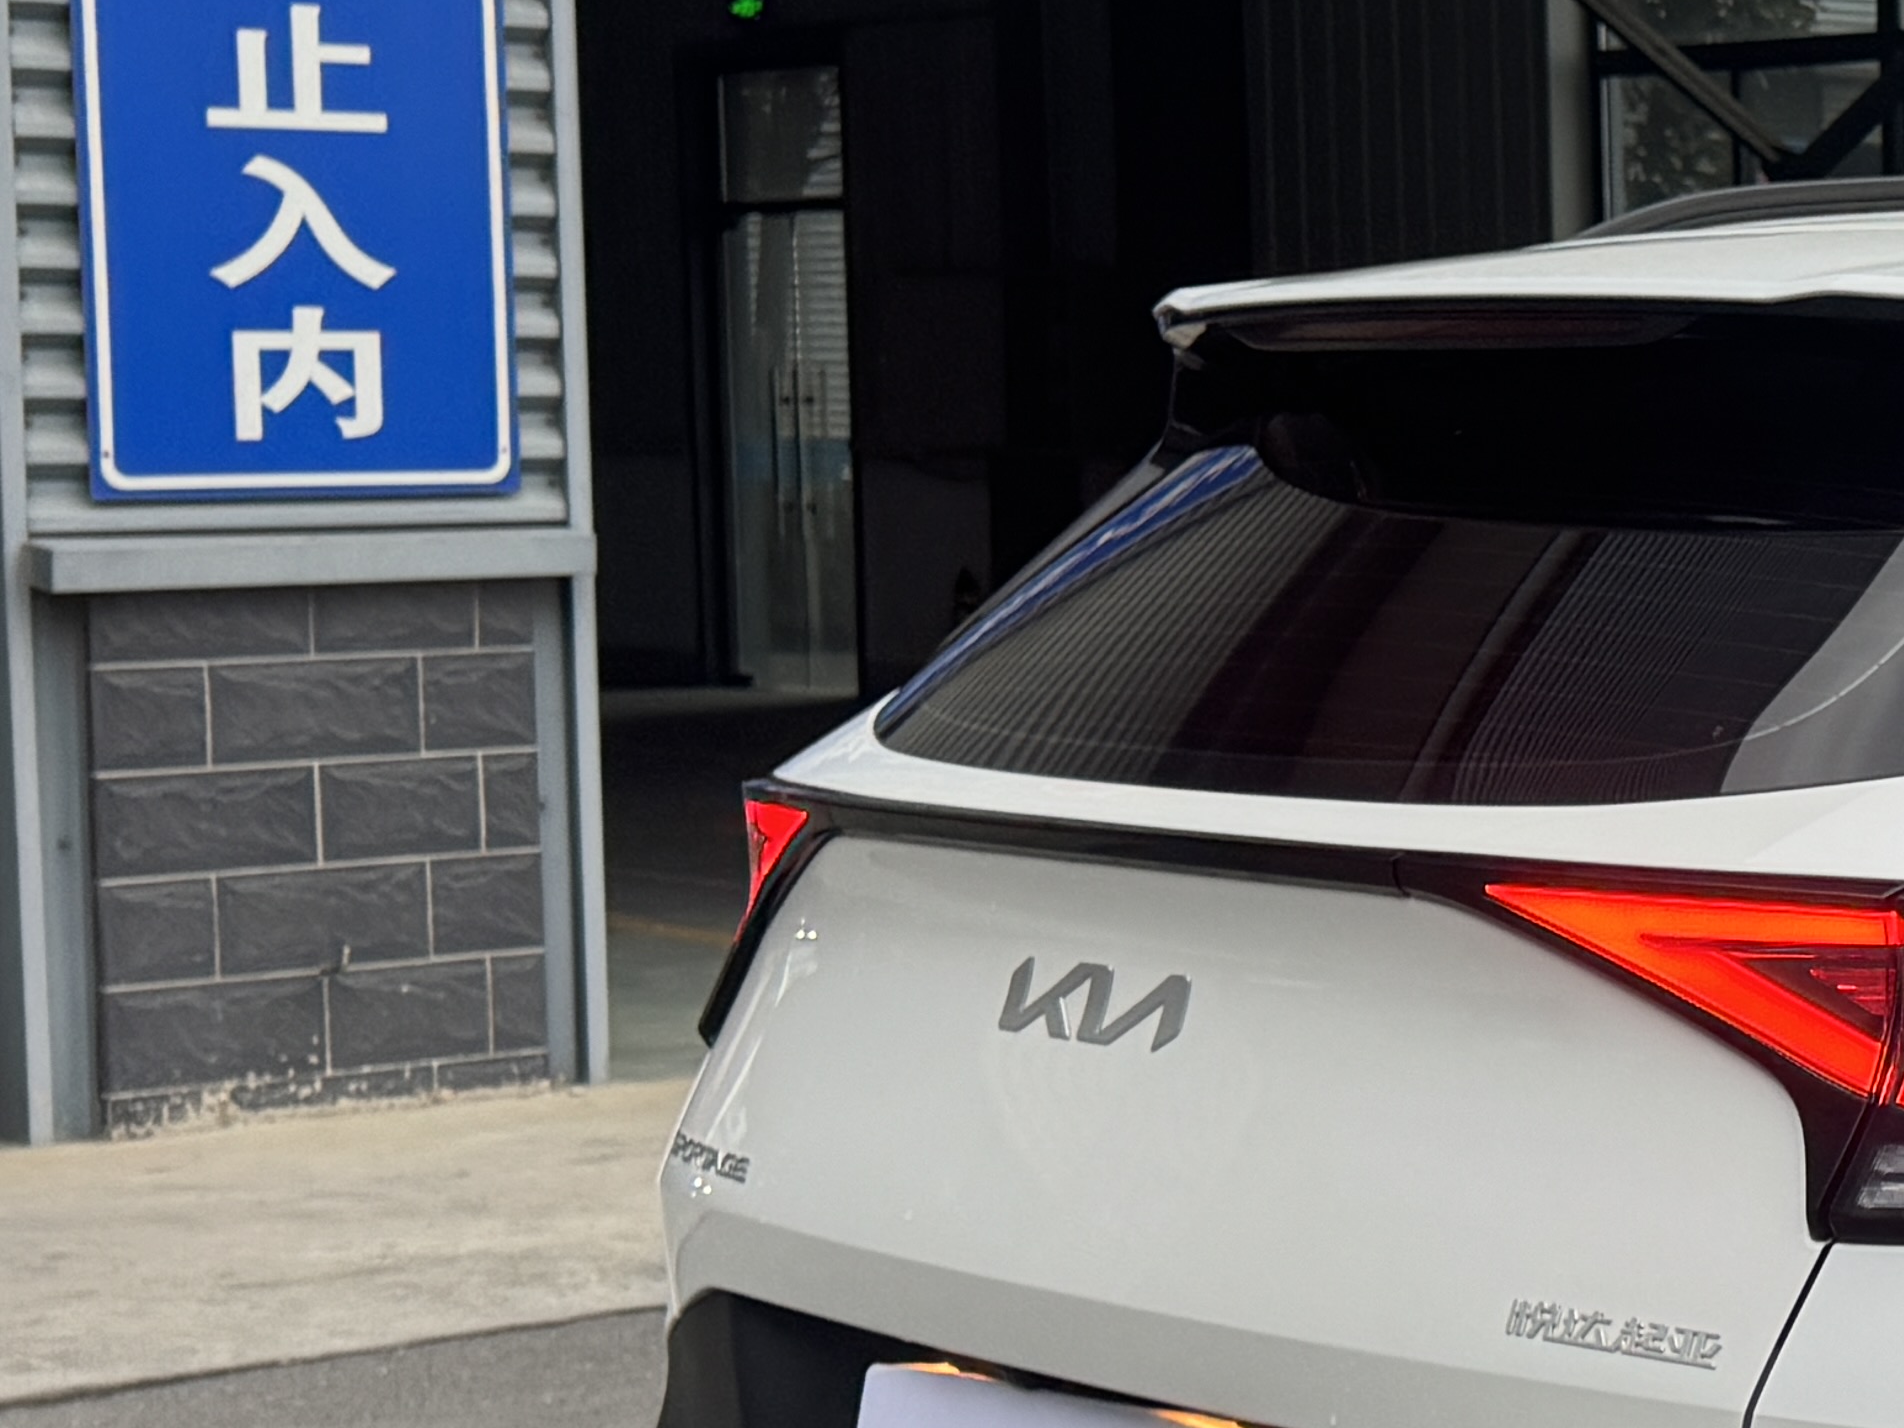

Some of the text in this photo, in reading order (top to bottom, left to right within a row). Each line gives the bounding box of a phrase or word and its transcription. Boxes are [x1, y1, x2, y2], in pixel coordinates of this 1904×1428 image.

[998, 955, 1192, 1054] KIA
[671, 1130, 750, 1184] PORTAGE
[1505, 1298, 1722, 1370] 悦达起亚
